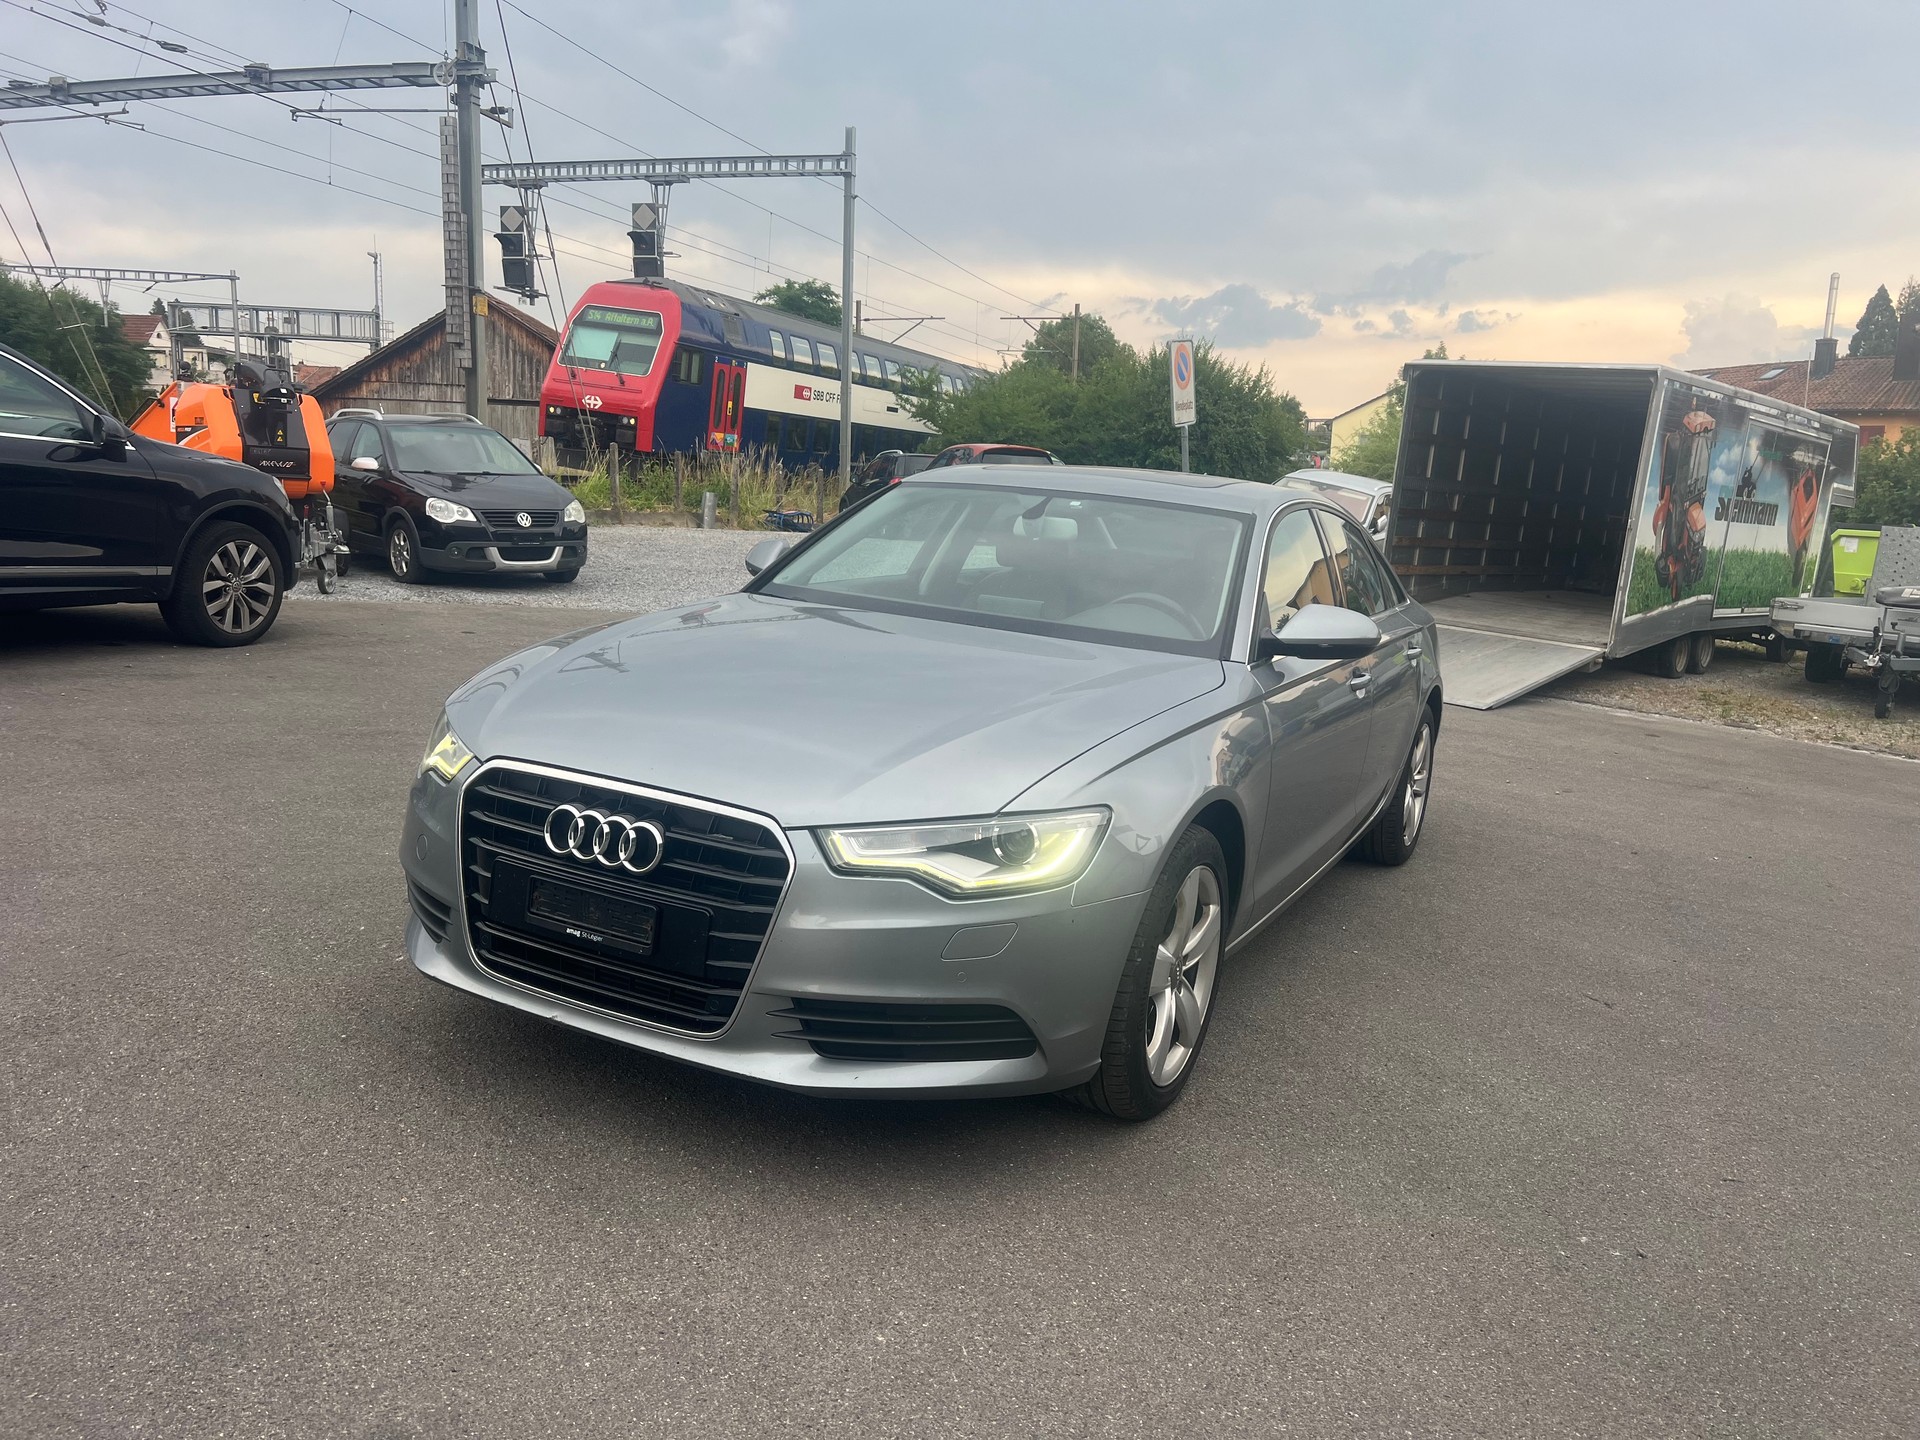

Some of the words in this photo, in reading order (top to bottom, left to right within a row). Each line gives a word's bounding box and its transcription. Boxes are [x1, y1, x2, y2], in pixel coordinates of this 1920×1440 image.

[588, 310, 602, 320] S14
[605, 312, 640, 325] Affoltern
[813, 390, 825, 402] SBB
[825, 392, 836, 403] CFF
[566, 928, 581, 938] amag
